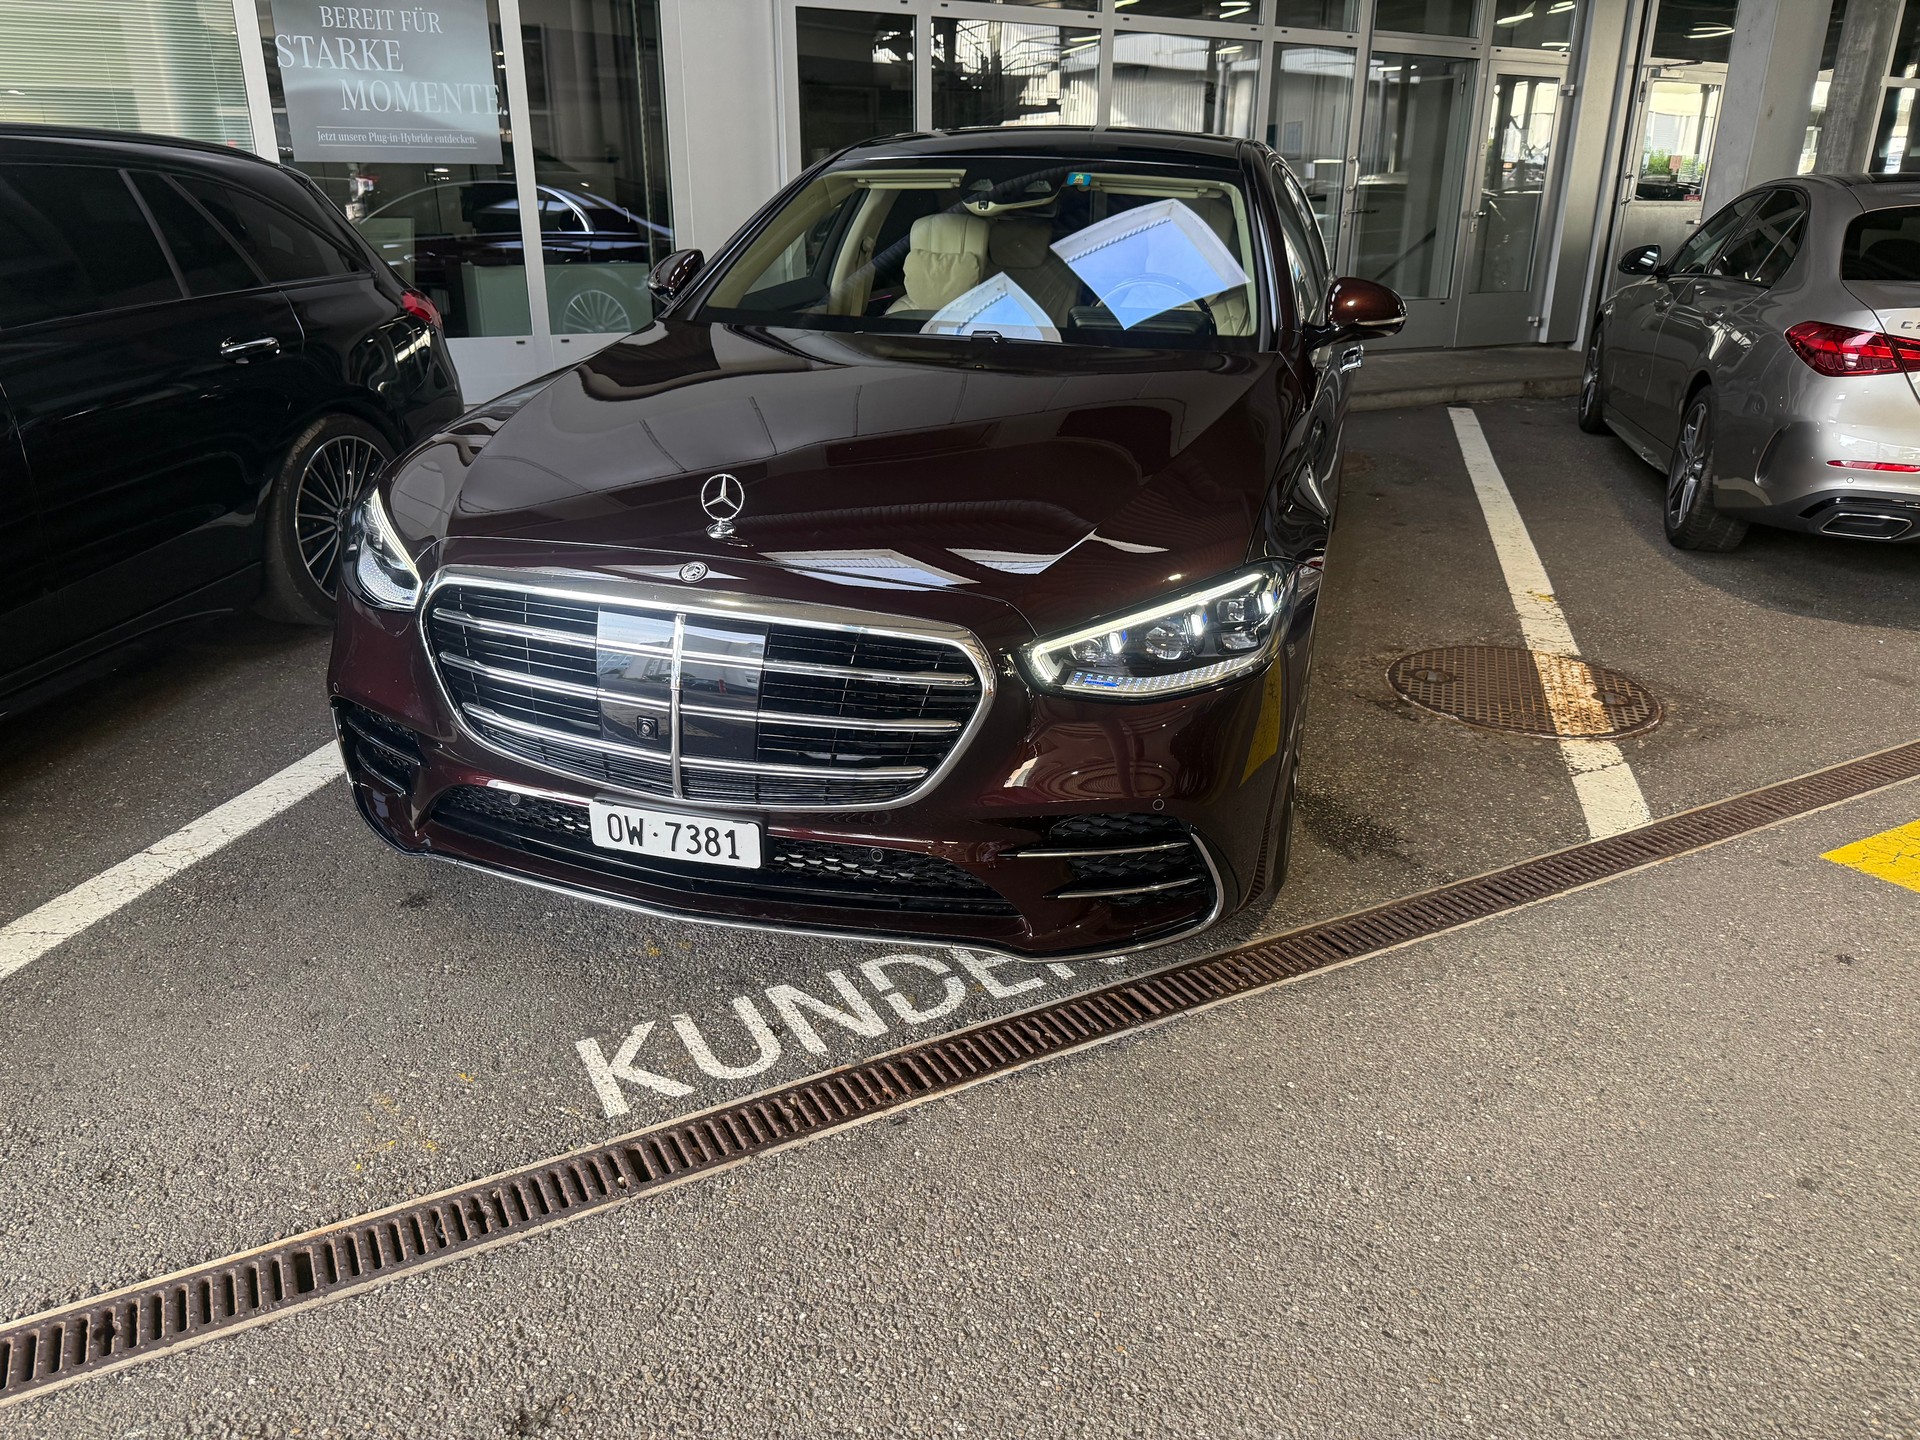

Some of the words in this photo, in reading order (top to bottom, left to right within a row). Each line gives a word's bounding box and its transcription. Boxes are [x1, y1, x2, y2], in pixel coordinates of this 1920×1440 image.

[319, 6, 394, 31] BEREIT
[400, 7, 443, 34] FÜR
[275, 34, 403, 72] STARKE
[339, 79, 508, 116] MOMENTE.
[317, 131, 336, 142] Jetzt
[338, 134, 367, 142] unsere
[368, 132, 433, 144] Plug-in-Hybride
[434, 134, 477, 144] entdecken.
[575, 946, 1127, 1118] KUNDE
